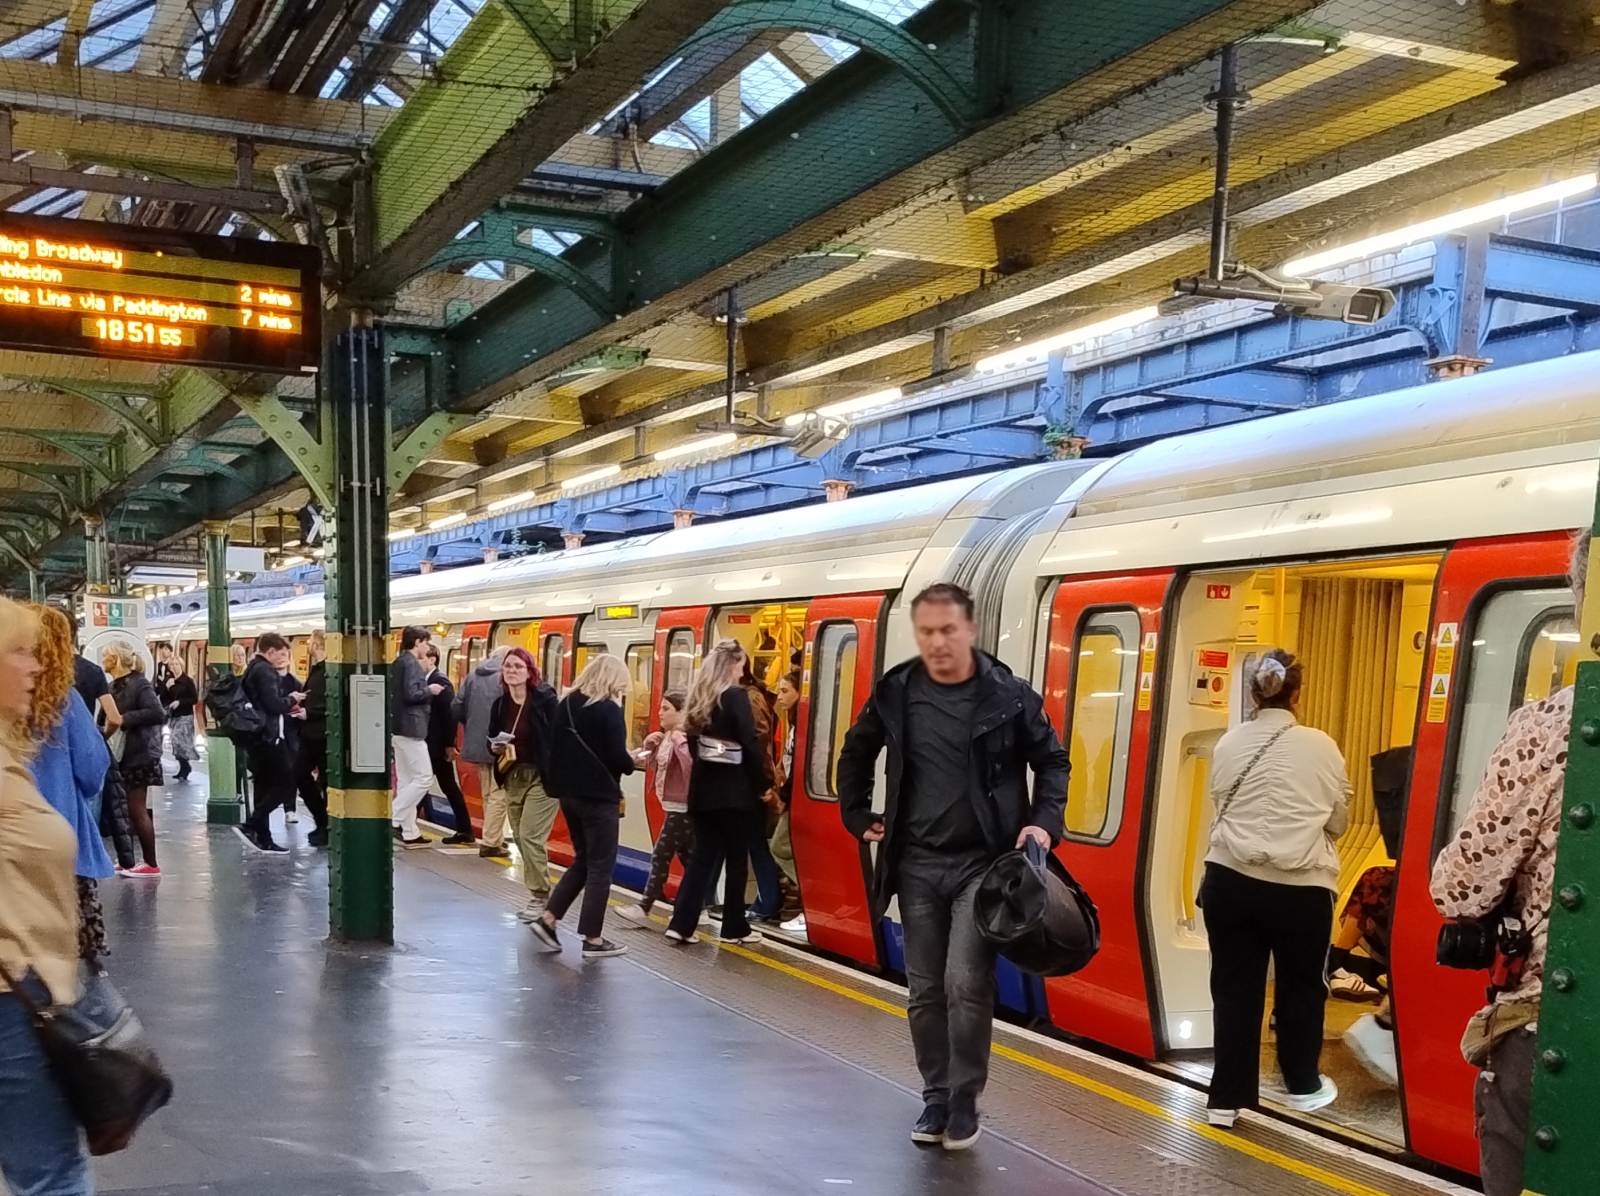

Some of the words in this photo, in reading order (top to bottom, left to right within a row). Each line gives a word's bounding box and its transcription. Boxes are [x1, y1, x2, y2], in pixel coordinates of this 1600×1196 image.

[36, 238, 123, 269] Broadway
[37, 287, 72, 309] Line
[79, 293, 106, 312] via
[113, 294, 208, 323] Paddington
[240, 284, 253, 303] 2
[241, 308, 253, 327] 7
